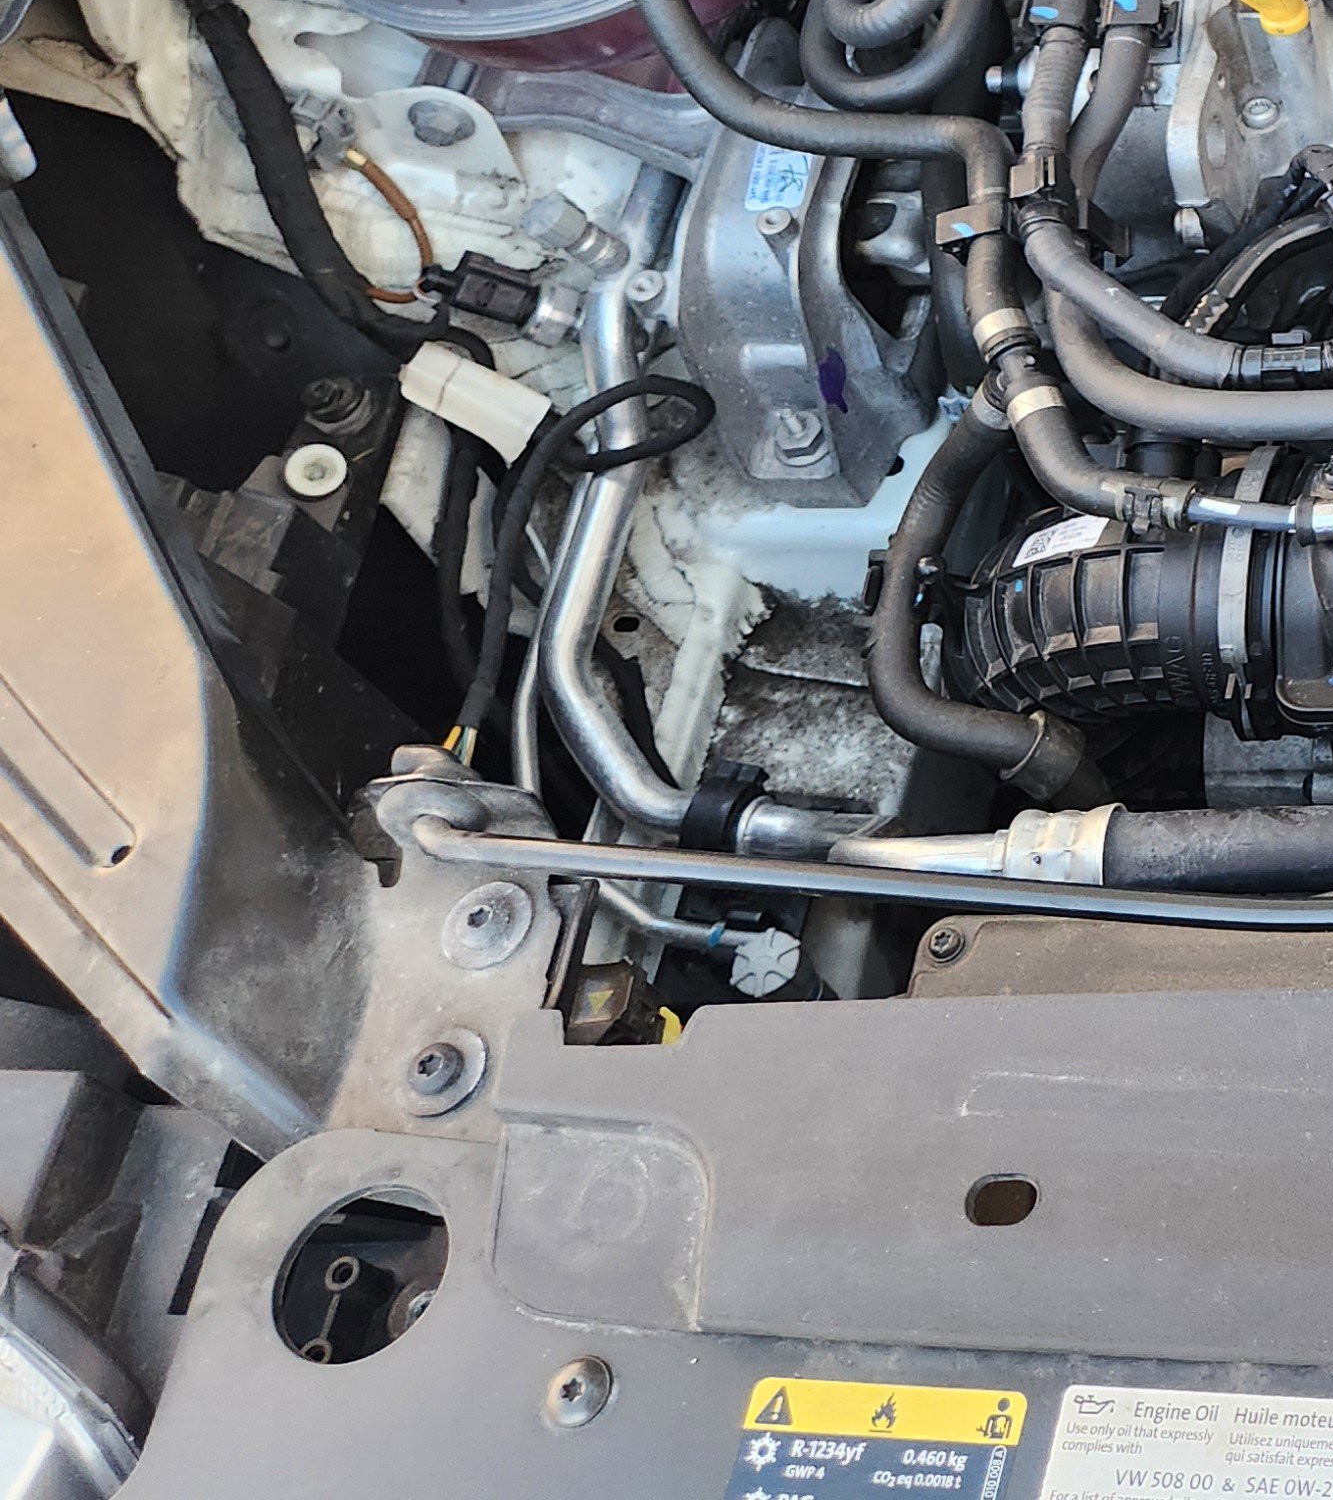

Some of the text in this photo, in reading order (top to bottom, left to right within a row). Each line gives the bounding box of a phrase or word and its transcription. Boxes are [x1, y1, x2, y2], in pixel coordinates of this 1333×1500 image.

[1134, 1401, 1220, 1424] Engine Oil
[1233, 1407, 1279, 1426] Huile
[1066, 1421, 1215, 1445] Use only oil that expressly
[1229, 1432, 1273, 1447] Utilisez
[790, 1439, 867, 1466] R-1234yf
[1062, 1439, 1143, 1456] complies with
[947, 1452, 968, 1471] kg
[1225, 1450, 1245, 1464] qui
[1246, 1450, 1295, 1465] satisfait
[783, 1464, 816, 1479] GWP
[896, 1473, 913, 1489] eq
[1115, 1468, 1148, 1487] VW
[1150, 1471, 1185, 1489] 508
[1189, 1473, 1213, 1491] 00
[1222, 1477, 1236, 1491] &
[1245, 1475, 1279, 1495] SAE
